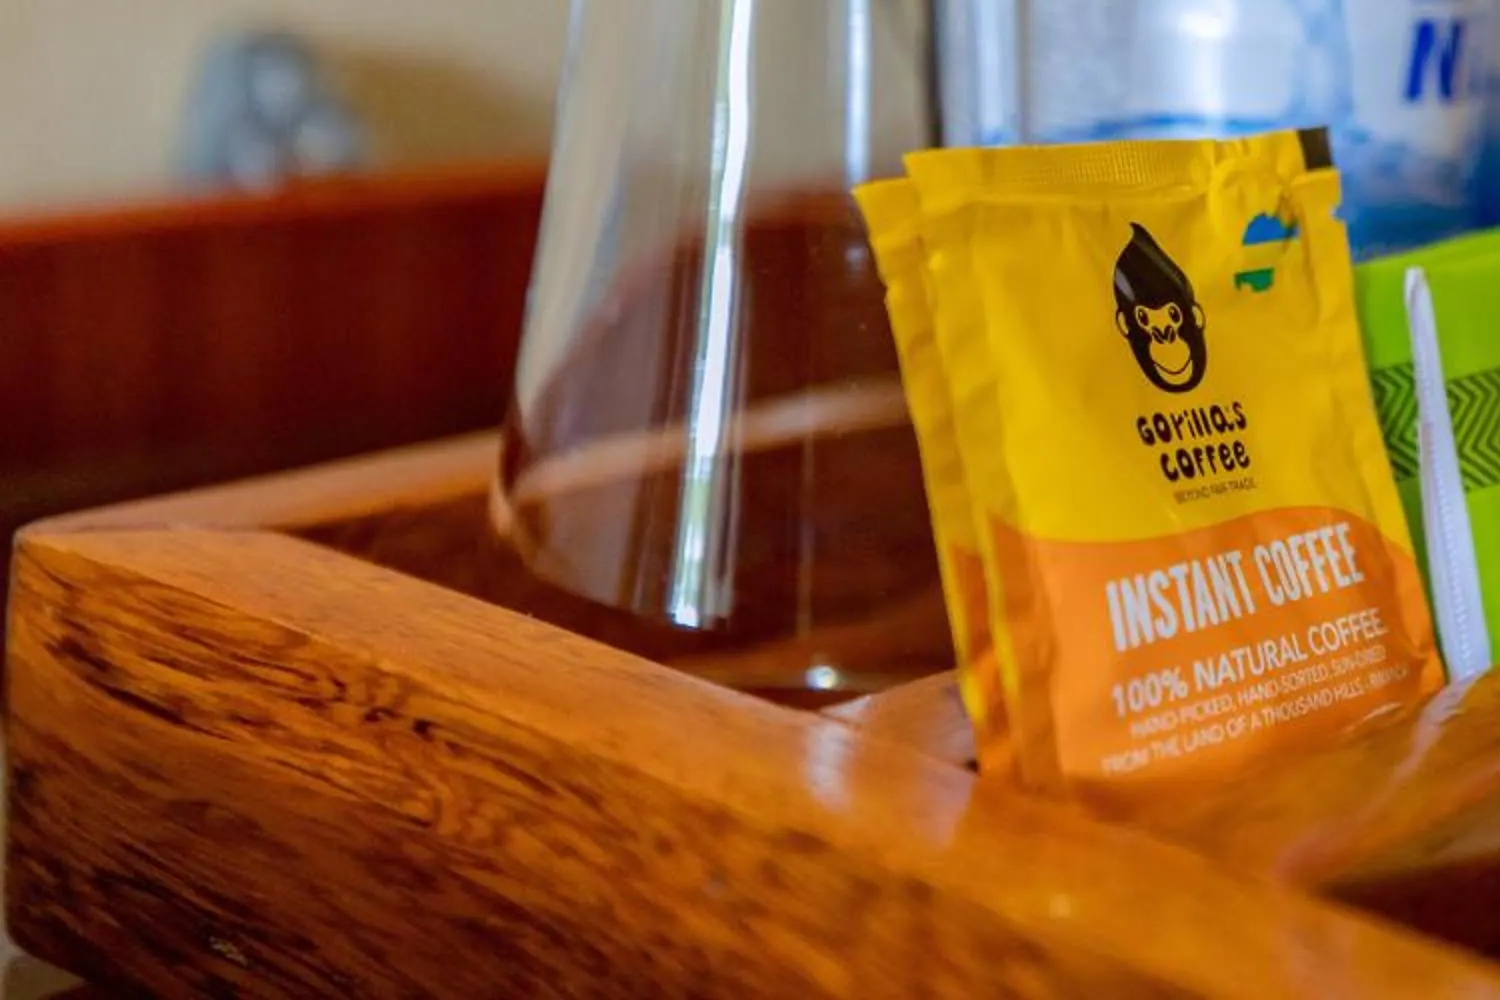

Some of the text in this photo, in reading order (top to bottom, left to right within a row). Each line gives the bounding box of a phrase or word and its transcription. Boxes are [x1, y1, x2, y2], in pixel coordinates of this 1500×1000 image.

[1106, 522, 1364, 652] INSTANT COFFEE
[1112, 607, 1388, 719] 100% NATURAL COFFEE
[1101, 748, 1150, 776] FROM
[1150, 734, 1183, 760] THE
[1183, 723, 1225, 753] LAND
[1226, 714, 1247, 738] OF
[1262, 687, 1334, 726] THOUSAND
